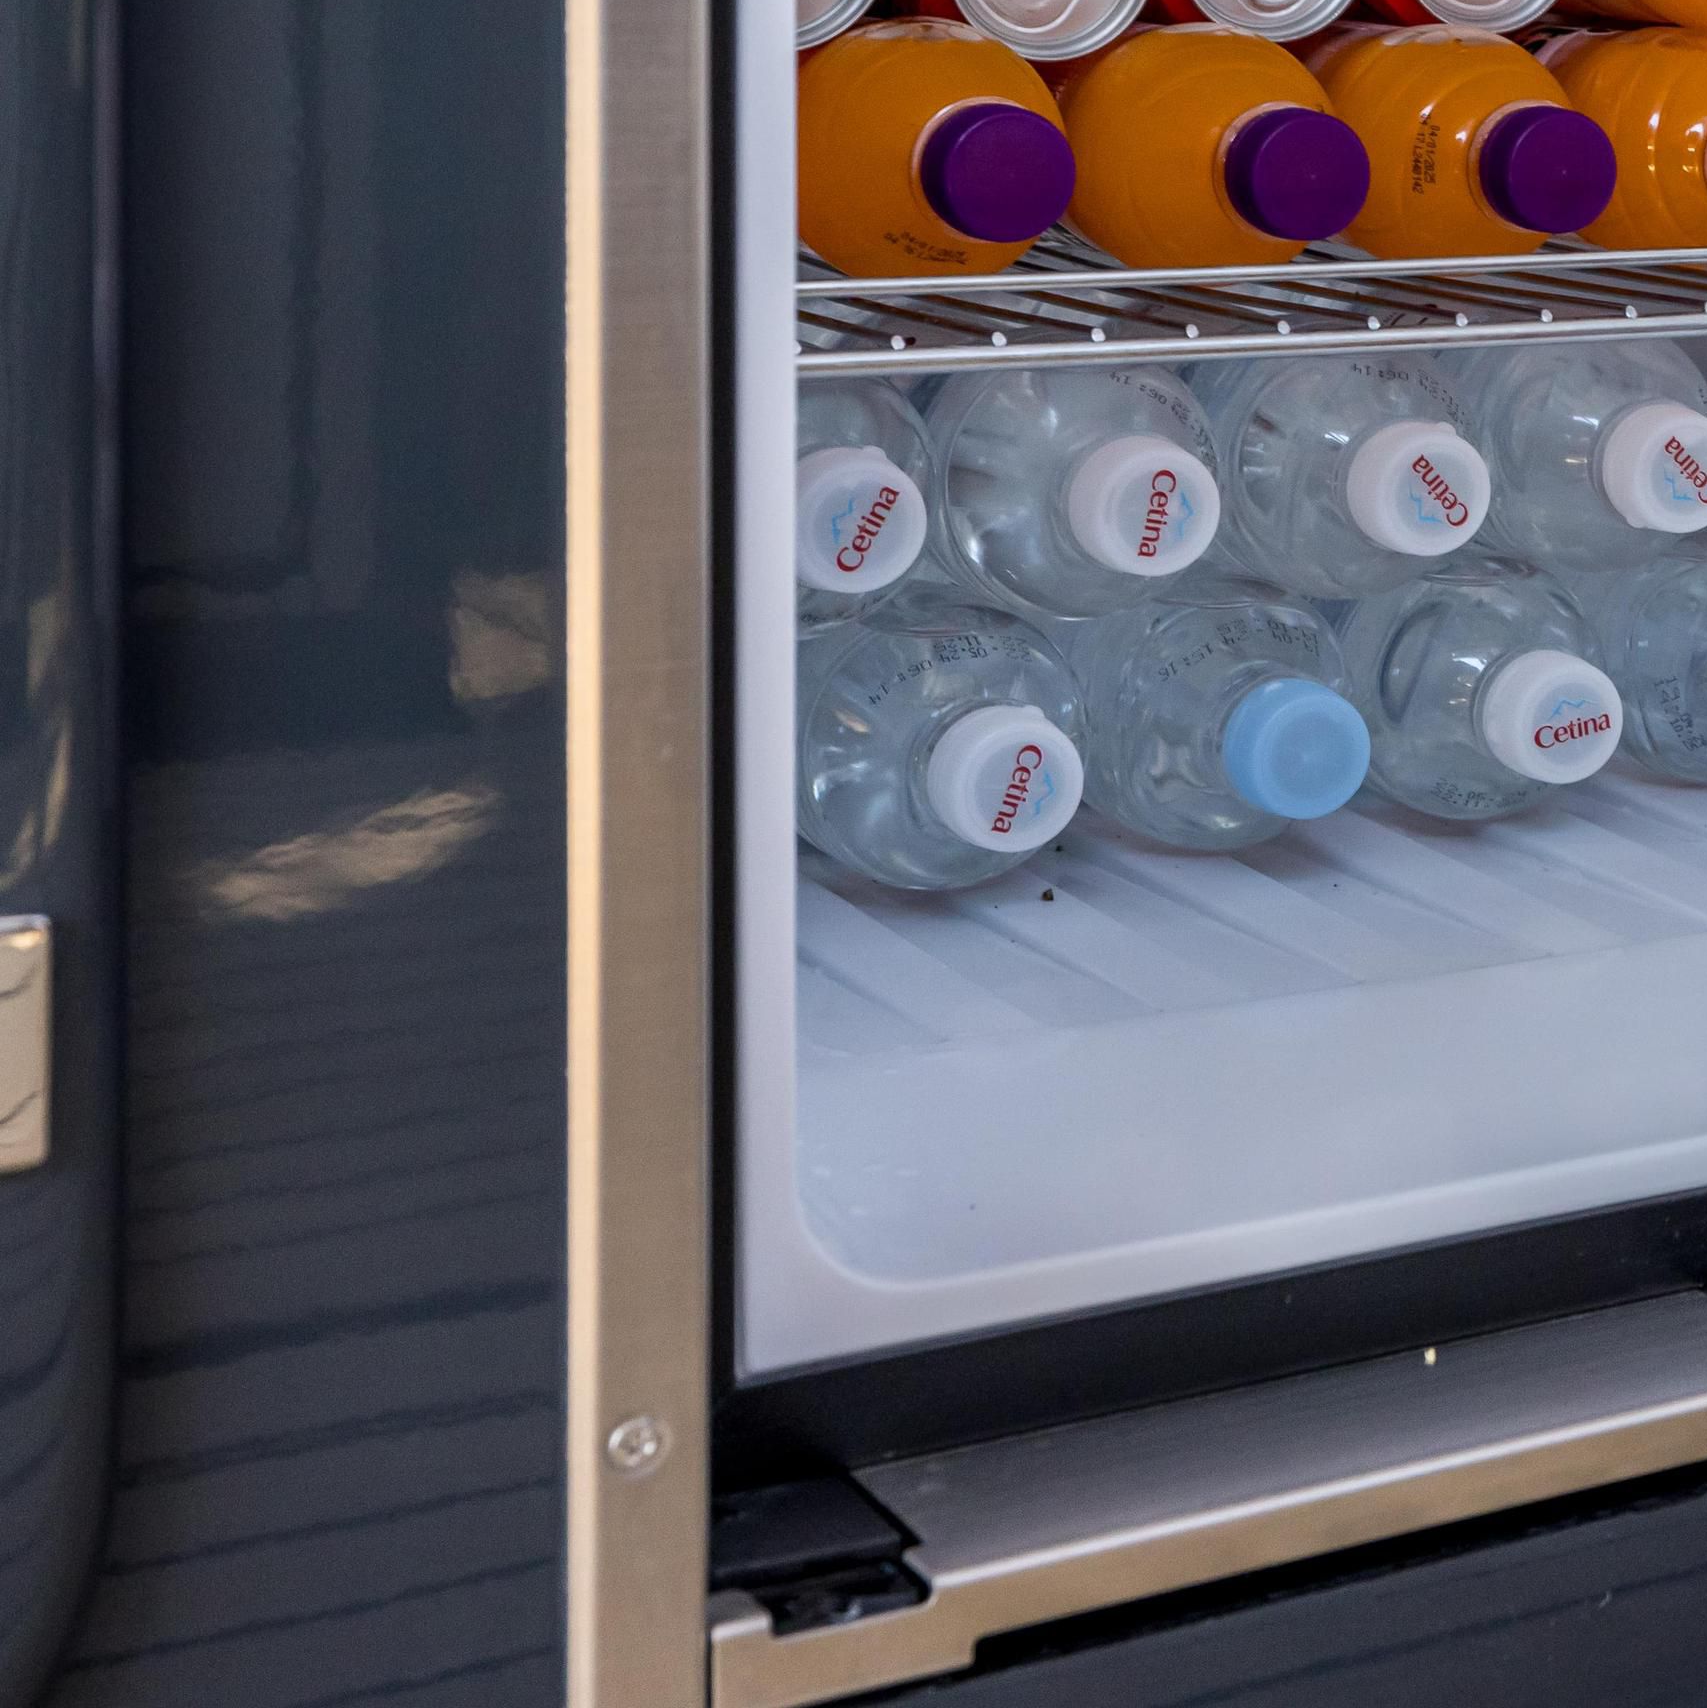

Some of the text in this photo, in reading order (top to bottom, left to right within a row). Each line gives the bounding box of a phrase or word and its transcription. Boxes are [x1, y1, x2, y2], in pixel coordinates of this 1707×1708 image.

[836, 485, 900, 573] Cetina
[1137, 469, 1177, 559] Cetina
[1411, 454, 1469, 528] Cetina
[1533, 710, 1612, 750] Cetina
[991, 744, 1043, 835] Cetina
